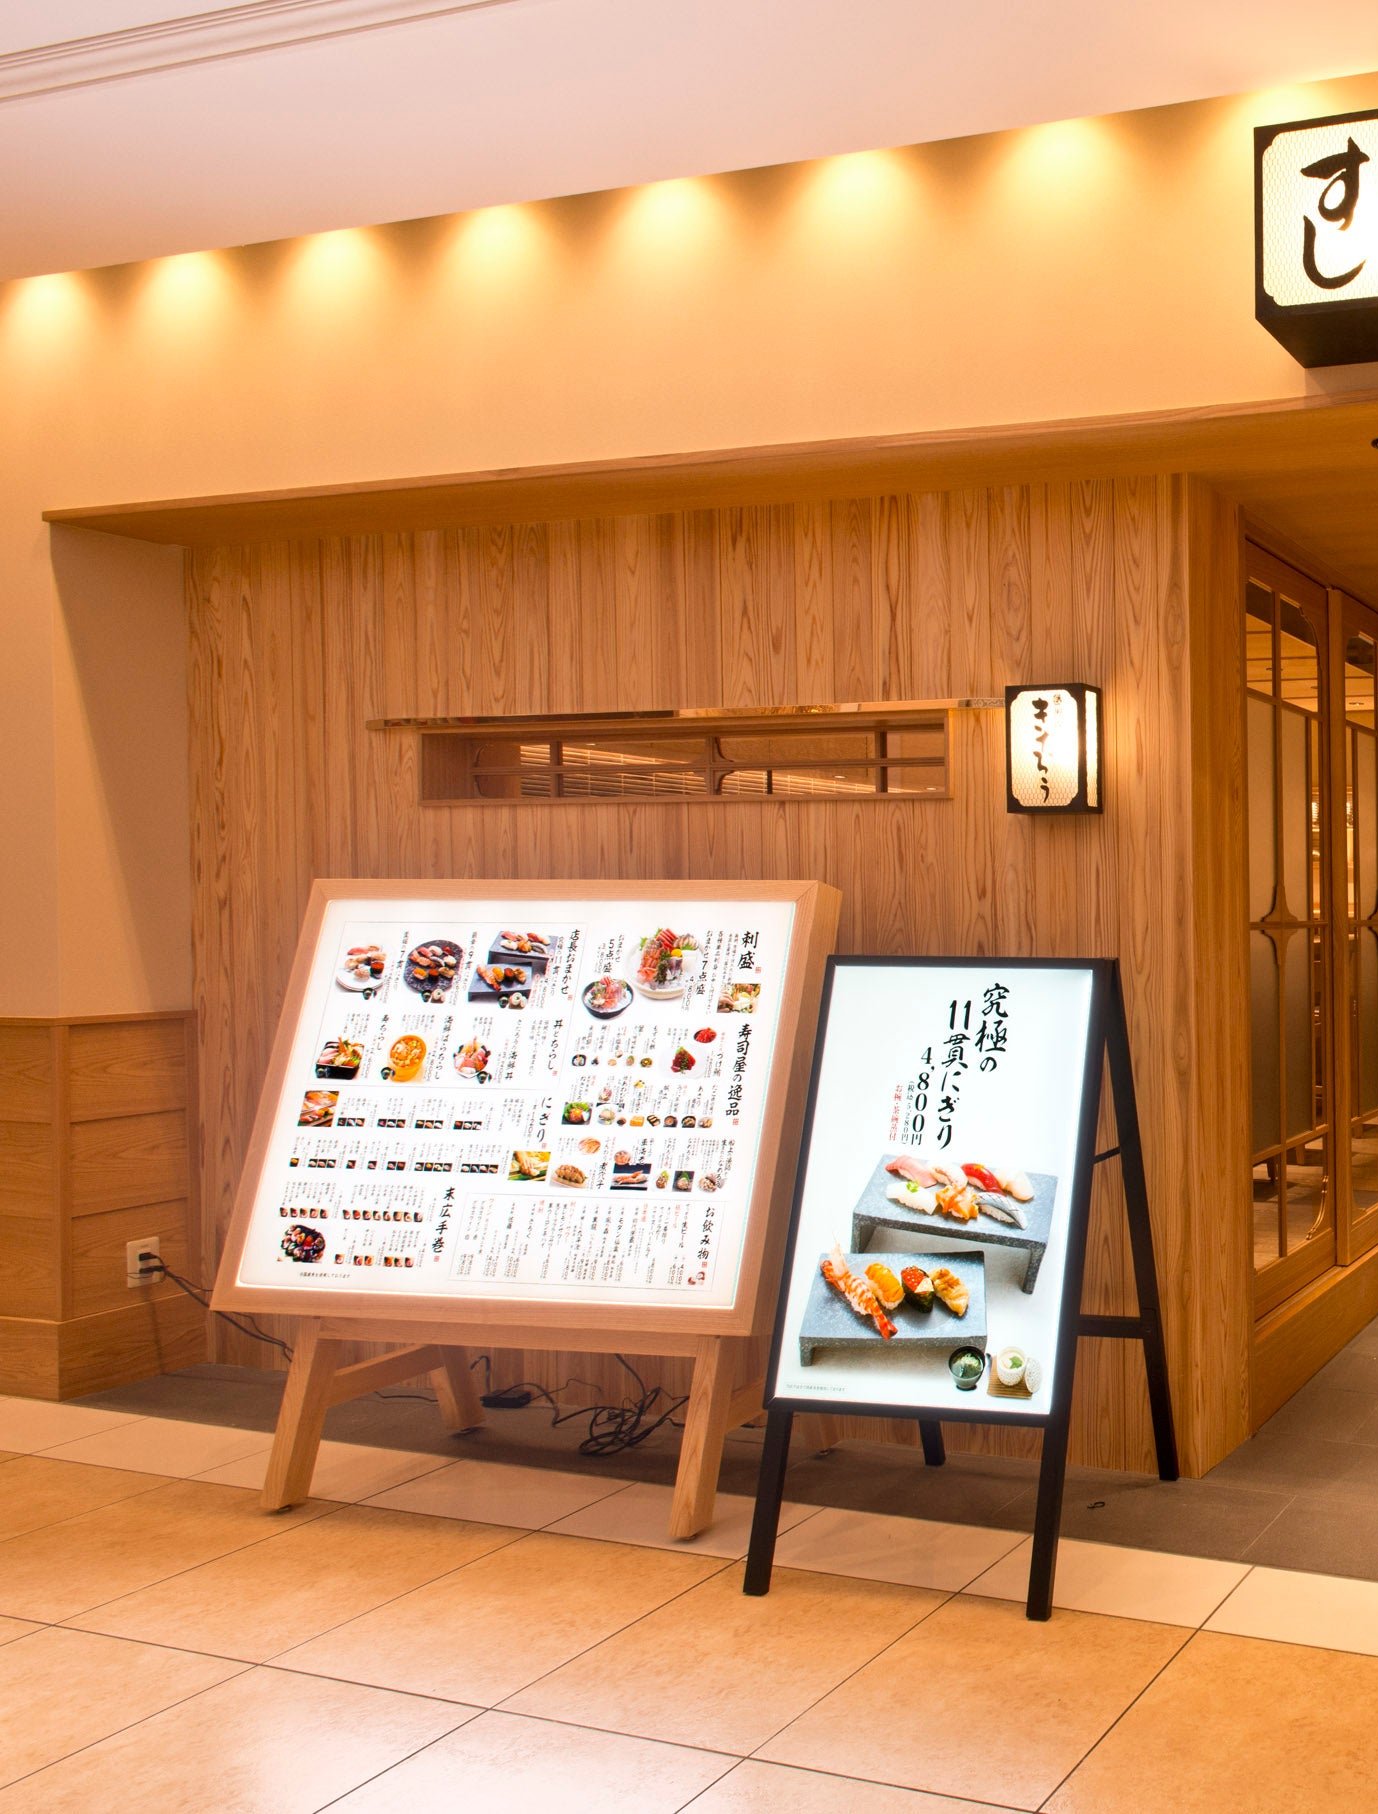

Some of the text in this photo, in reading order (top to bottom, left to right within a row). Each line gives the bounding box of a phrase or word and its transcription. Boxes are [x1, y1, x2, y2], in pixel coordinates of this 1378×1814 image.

[1300, 136, 1370, 289] すし
[561, 929, 580, 995] 店長おまかせ
[737, 930, 759, 970] 刺盛
[975, 983, 1010, 1072] 究極の
[725, 1023, 753, 1117] 寿司屋の逸品
[911, 1047, 935, 1146] 4,800円
[937, 1000, 971, 1150] 11貫にぎり
[536, 1097, 552, 1143] にぎり
[432, 1187, 455, 1254] 末広手巻
[697, 1206, 716, 1260] お飲み物
